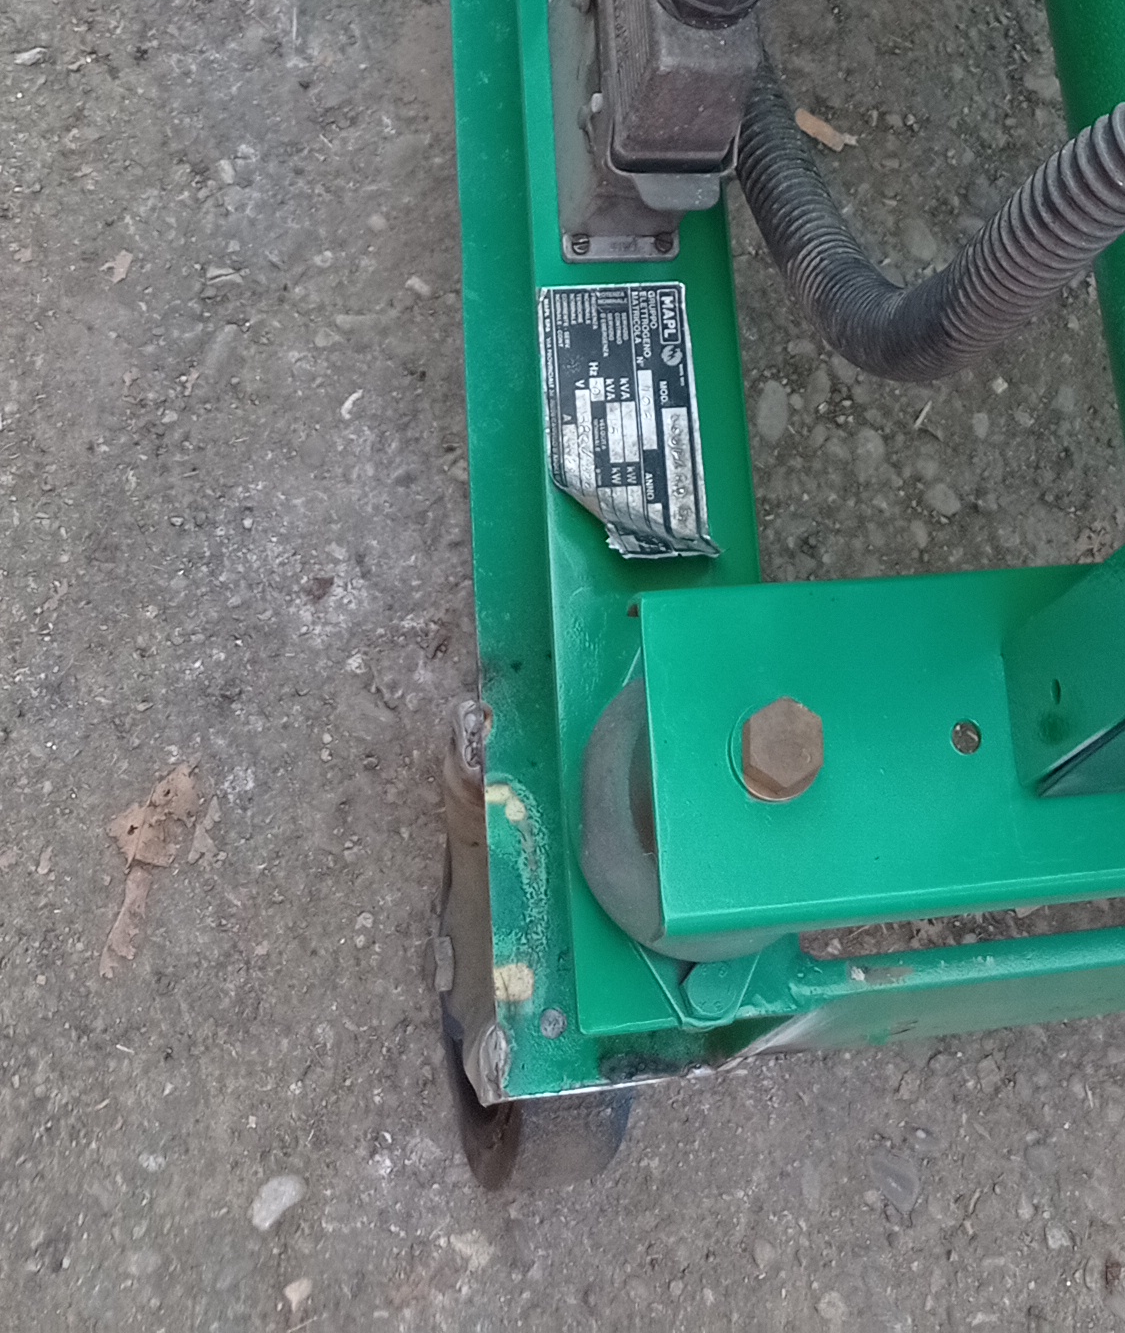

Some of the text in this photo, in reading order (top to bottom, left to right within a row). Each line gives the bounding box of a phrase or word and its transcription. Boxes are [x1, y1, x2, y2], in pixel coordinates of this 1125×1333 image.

[554, 293, 562, 325] NOMINALE
[560, 293, 569, 327] CORRENTE
[568, 293, 576, 325] NOMINALE
[575, 292, 583, 323] TENSIONE
[582, 292, 591, 324] NOMINALE
[589, 292, 598, 329] FREQUENZA
[630, 290, 641, 343] MATRICOLA
[647, 290, 657, 329] GRUPPO
[660, 295, 676, 338] MAPL
[613, 312, 622, 345] CONTINUO
[638, 290, 651, 358] ELETTROGENO
[574, 379, 585, 388] V
[588, 361, 598, 376] Hz
[604, 377, 615, 400] kVA
[618, 377, 630, 399] kVA
[658, 380, 668, 405] MOD.
[562, 413, 571, 422] A
[610, 467, 621, 484] kW
[625, 466, 636, 483] kW
[644, 472, 654, 500] ANNO
